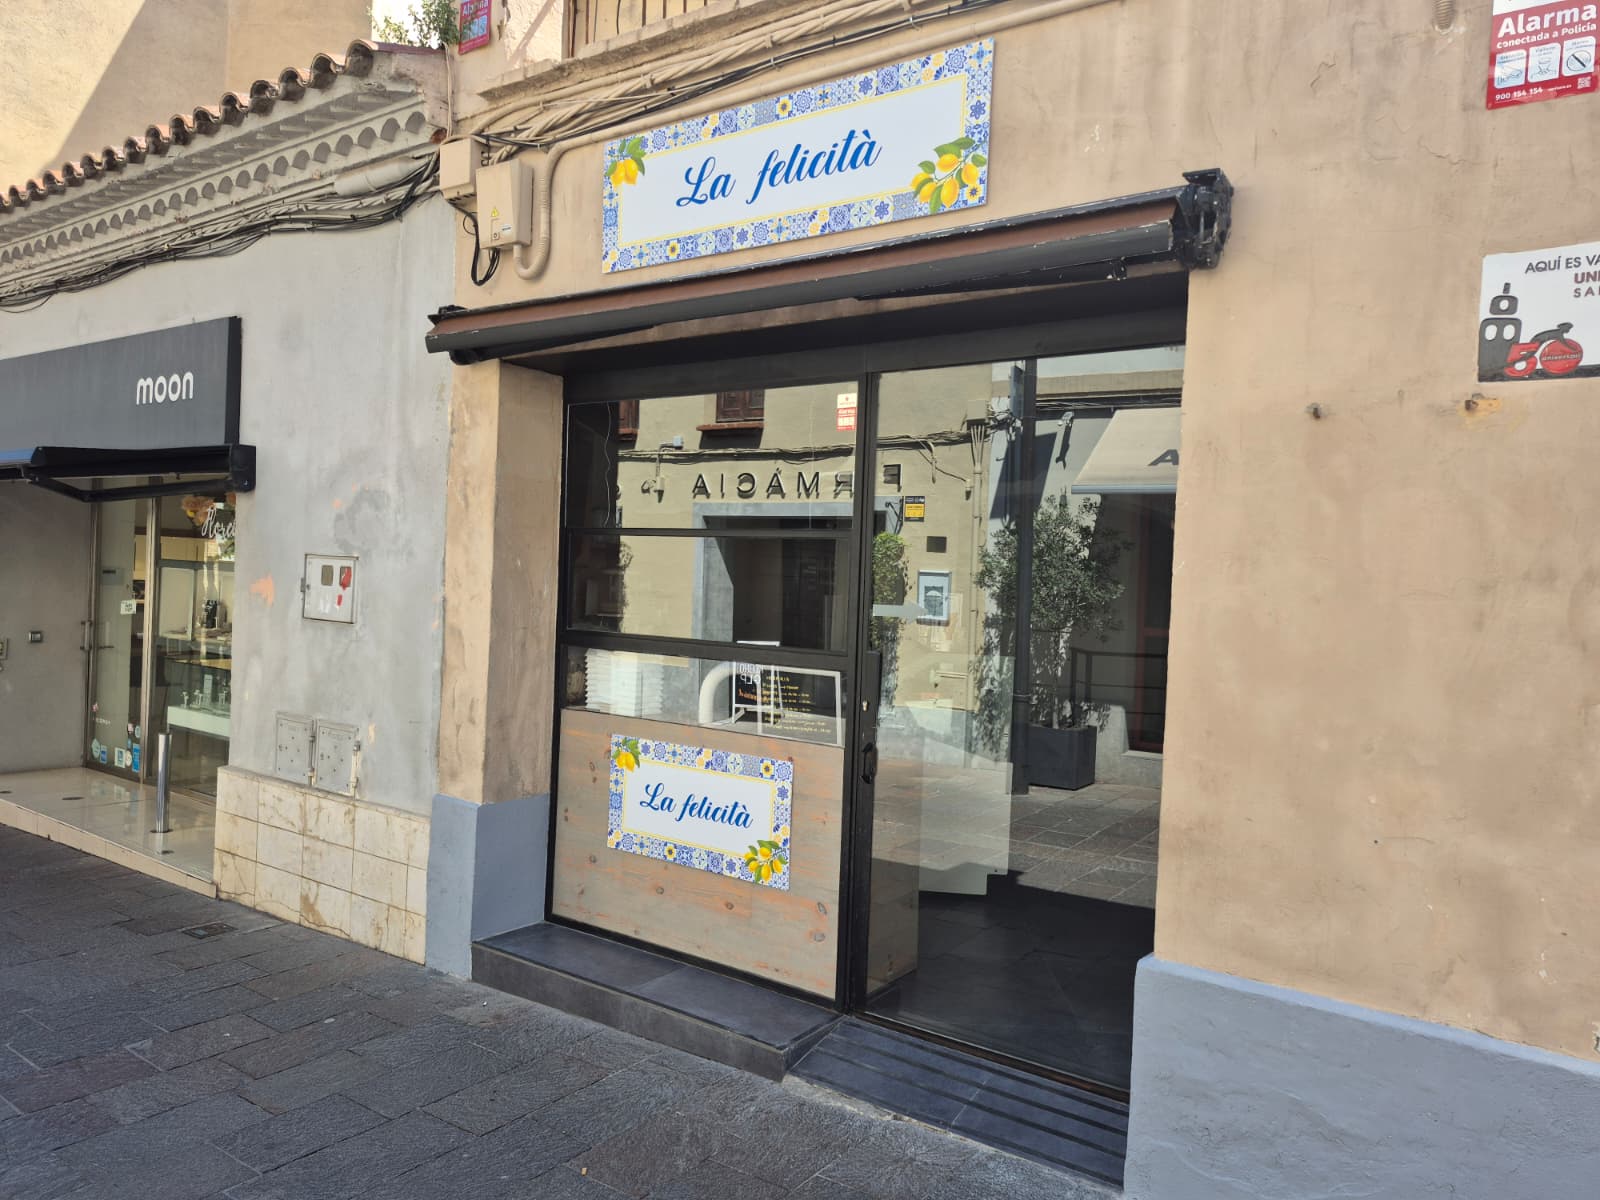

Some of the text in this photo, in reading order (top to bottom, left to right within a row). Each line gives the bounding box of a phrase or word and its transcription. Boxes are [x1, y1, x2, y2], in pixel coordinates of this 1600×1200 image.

[1497, 4, 1597, 38] Alarma
[1496, 32, 1550, 49] conectada
[1495, 93, 1511, 101] 900
[675, 128, 882, 207] La felicità
[1524, 255, 1562, 275] AQUÍ
[1565, 256, 1582, 269] ES
[136, 371, 194, 406] moon
[640, 782, 754, 828] La felicità
